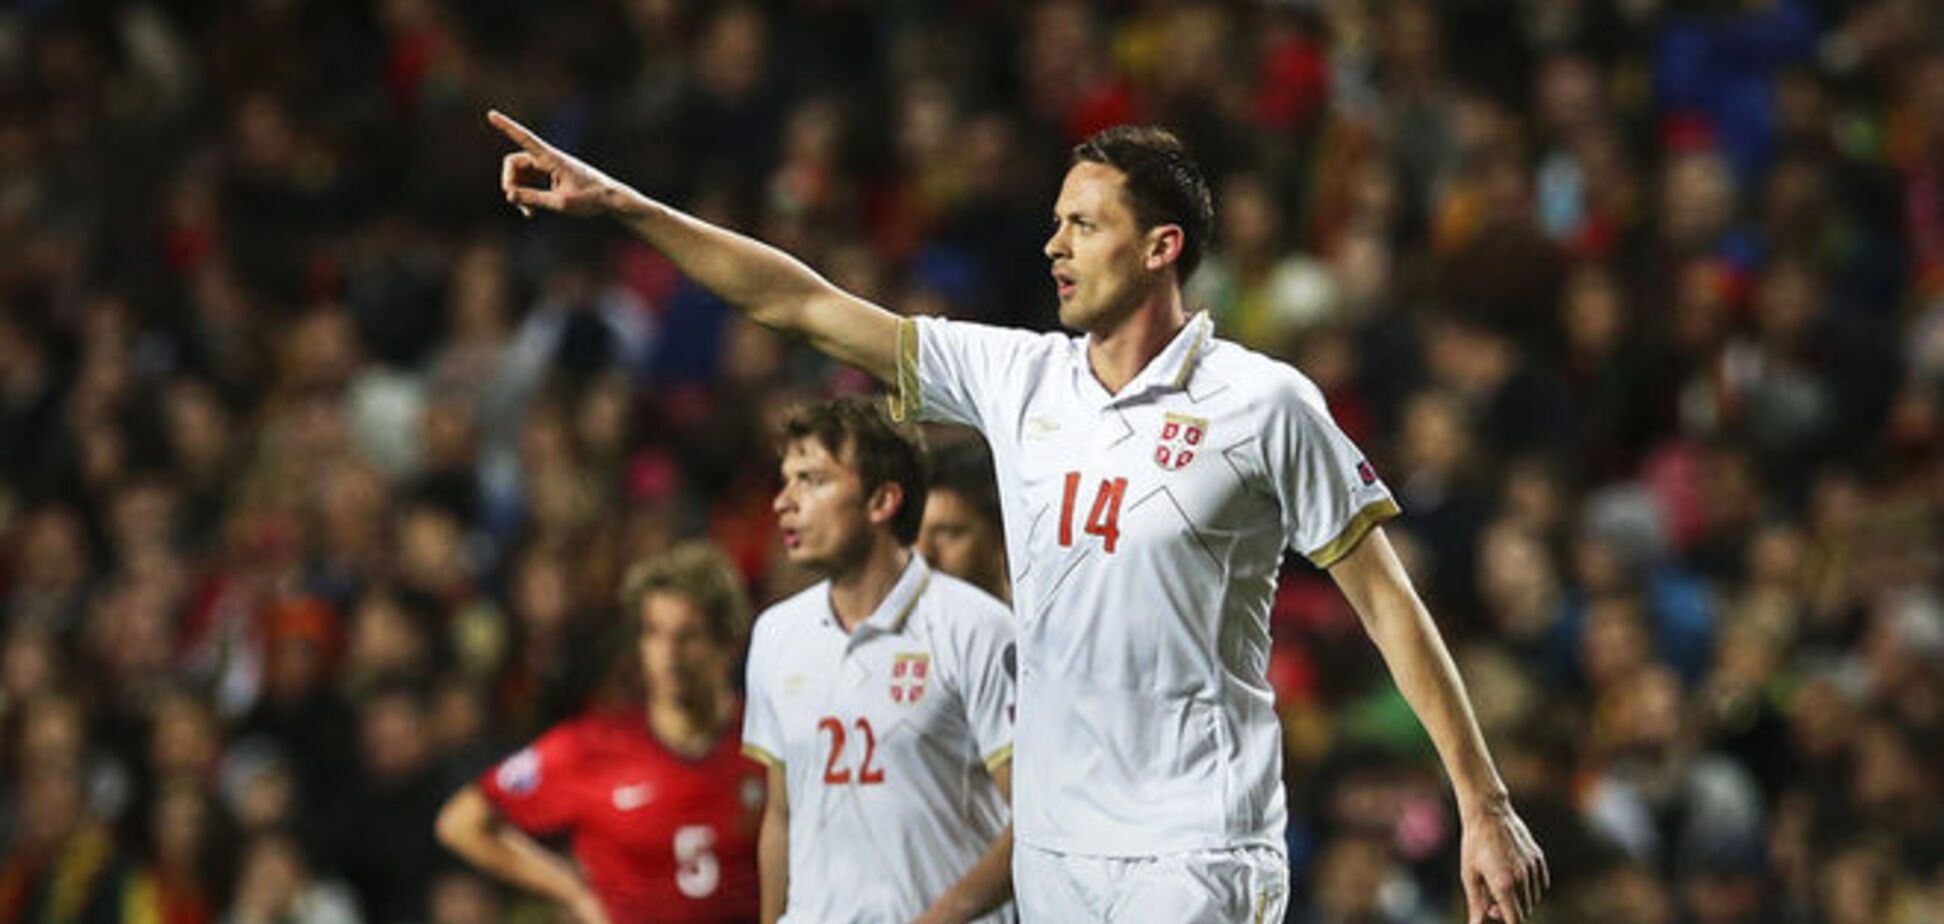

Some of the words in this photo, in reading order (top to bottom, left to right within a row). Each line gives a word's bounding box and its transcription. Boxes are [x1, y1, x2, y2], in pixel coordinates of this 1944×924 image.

[1058, 471, 1128, 554] 14
[818, 716, 885, 784] 22
[674, 826, 720, 898] 5
